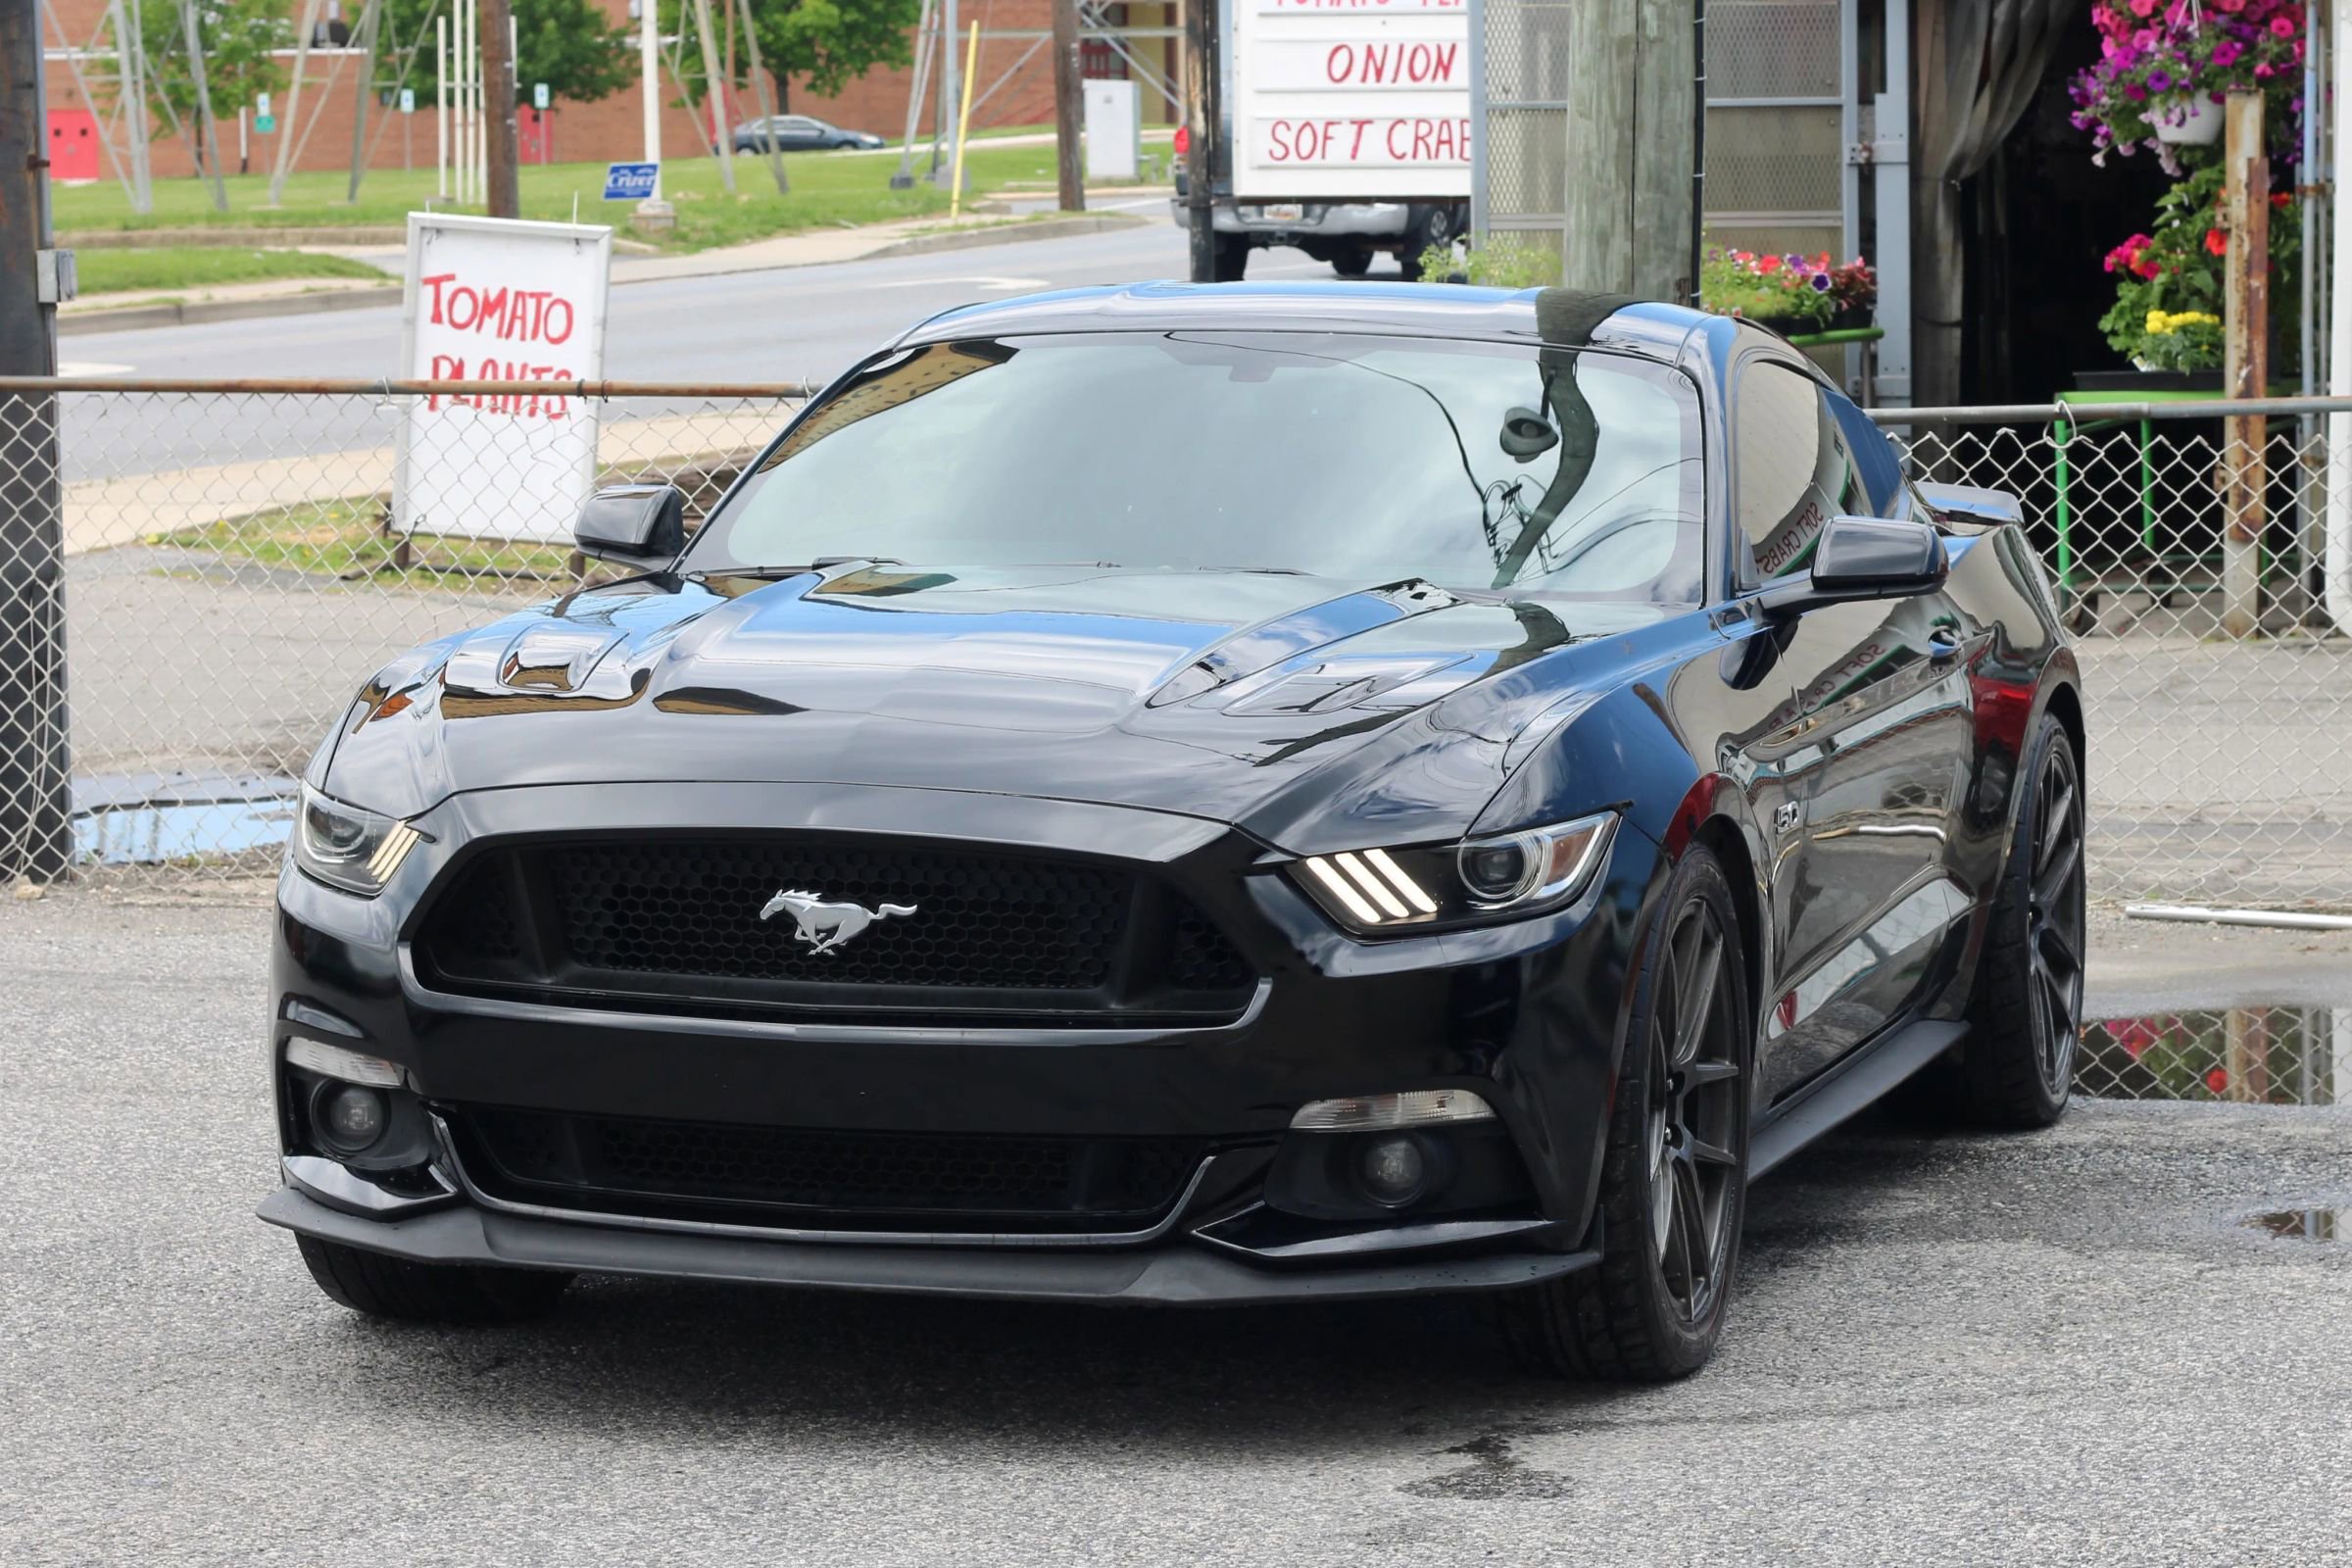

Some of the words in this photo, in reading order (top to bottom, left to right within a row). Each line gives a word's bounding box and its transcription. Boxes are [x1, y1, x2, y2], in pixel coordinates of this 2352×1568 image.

[1327, 43, 1456, 83] ONION
[1269, 120, 1374, 161] SOFT
[420, 273, 574, 345] TOMATO
[427, 354, 573, 420] PLANTS
